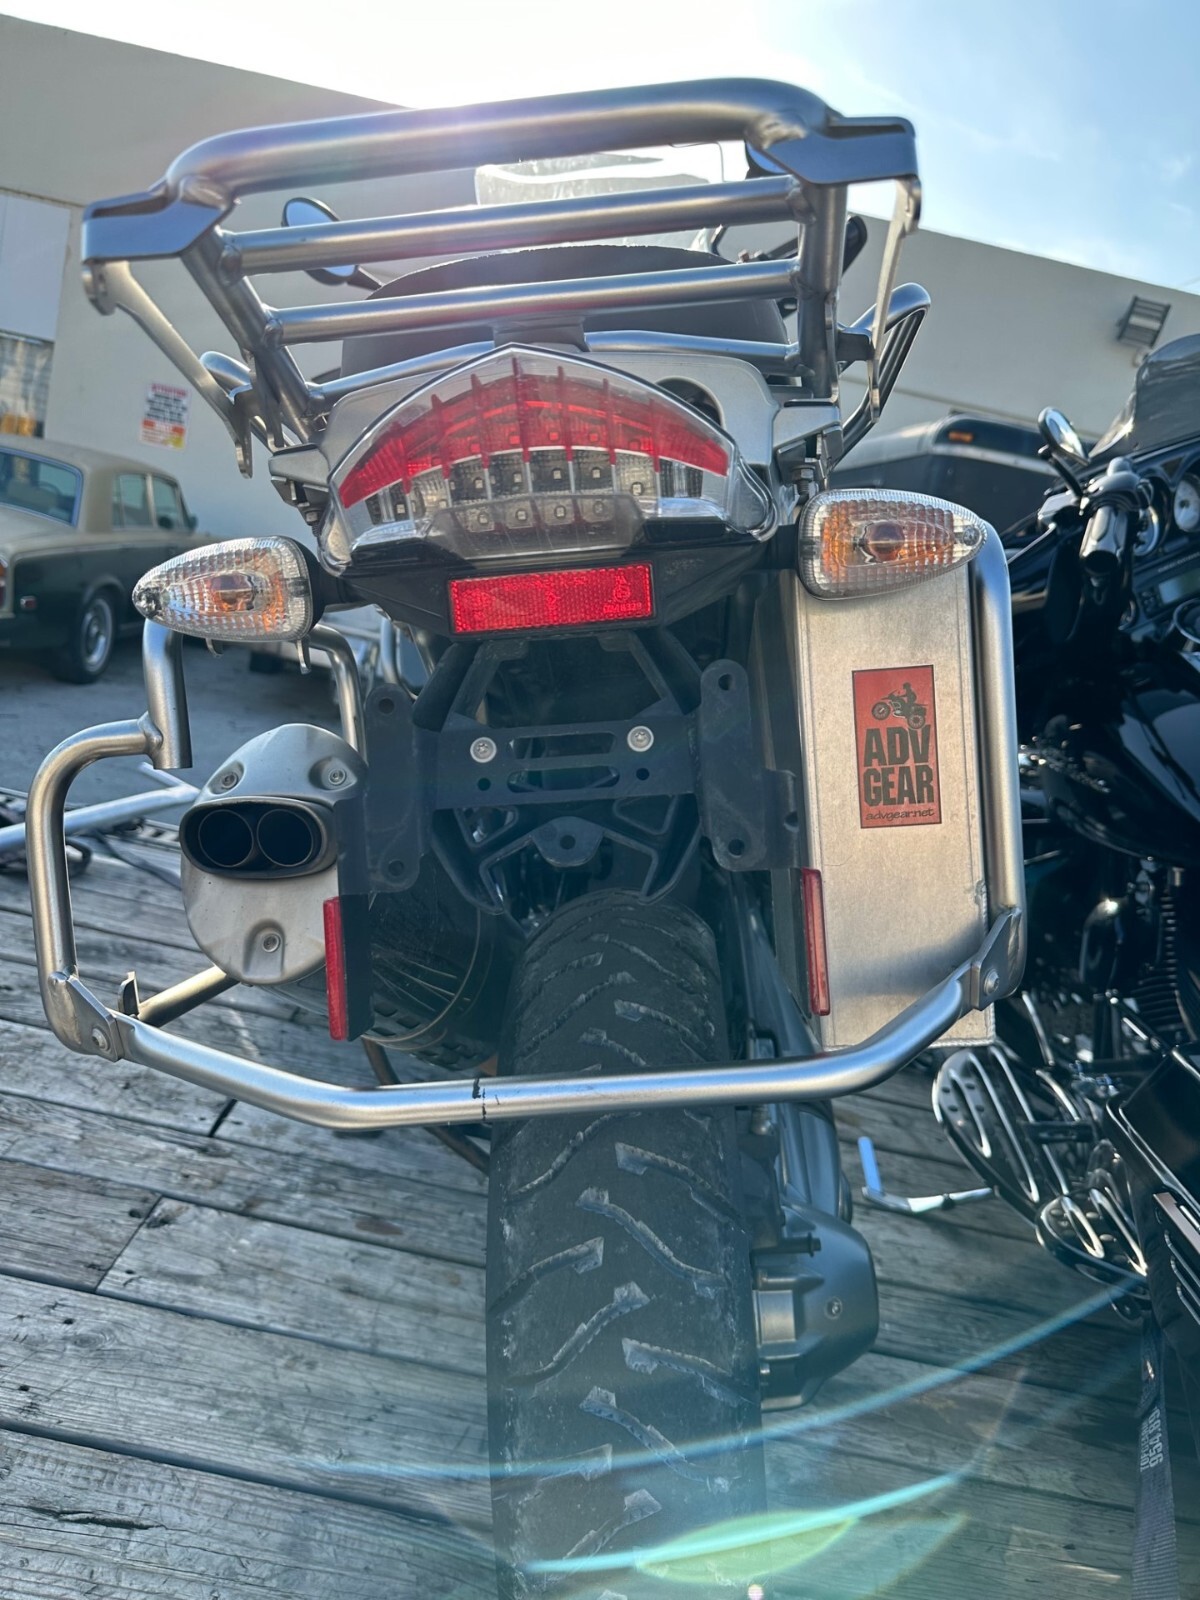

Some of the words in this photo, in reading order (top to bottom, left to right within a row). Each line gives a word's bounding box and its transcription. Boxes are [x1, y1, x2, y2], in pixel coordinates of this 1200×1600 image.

[863, 724, 931, 767] ADV
[863, 765, 934, 807] GEAR
[866, 808, 935, 821] advgear.net
